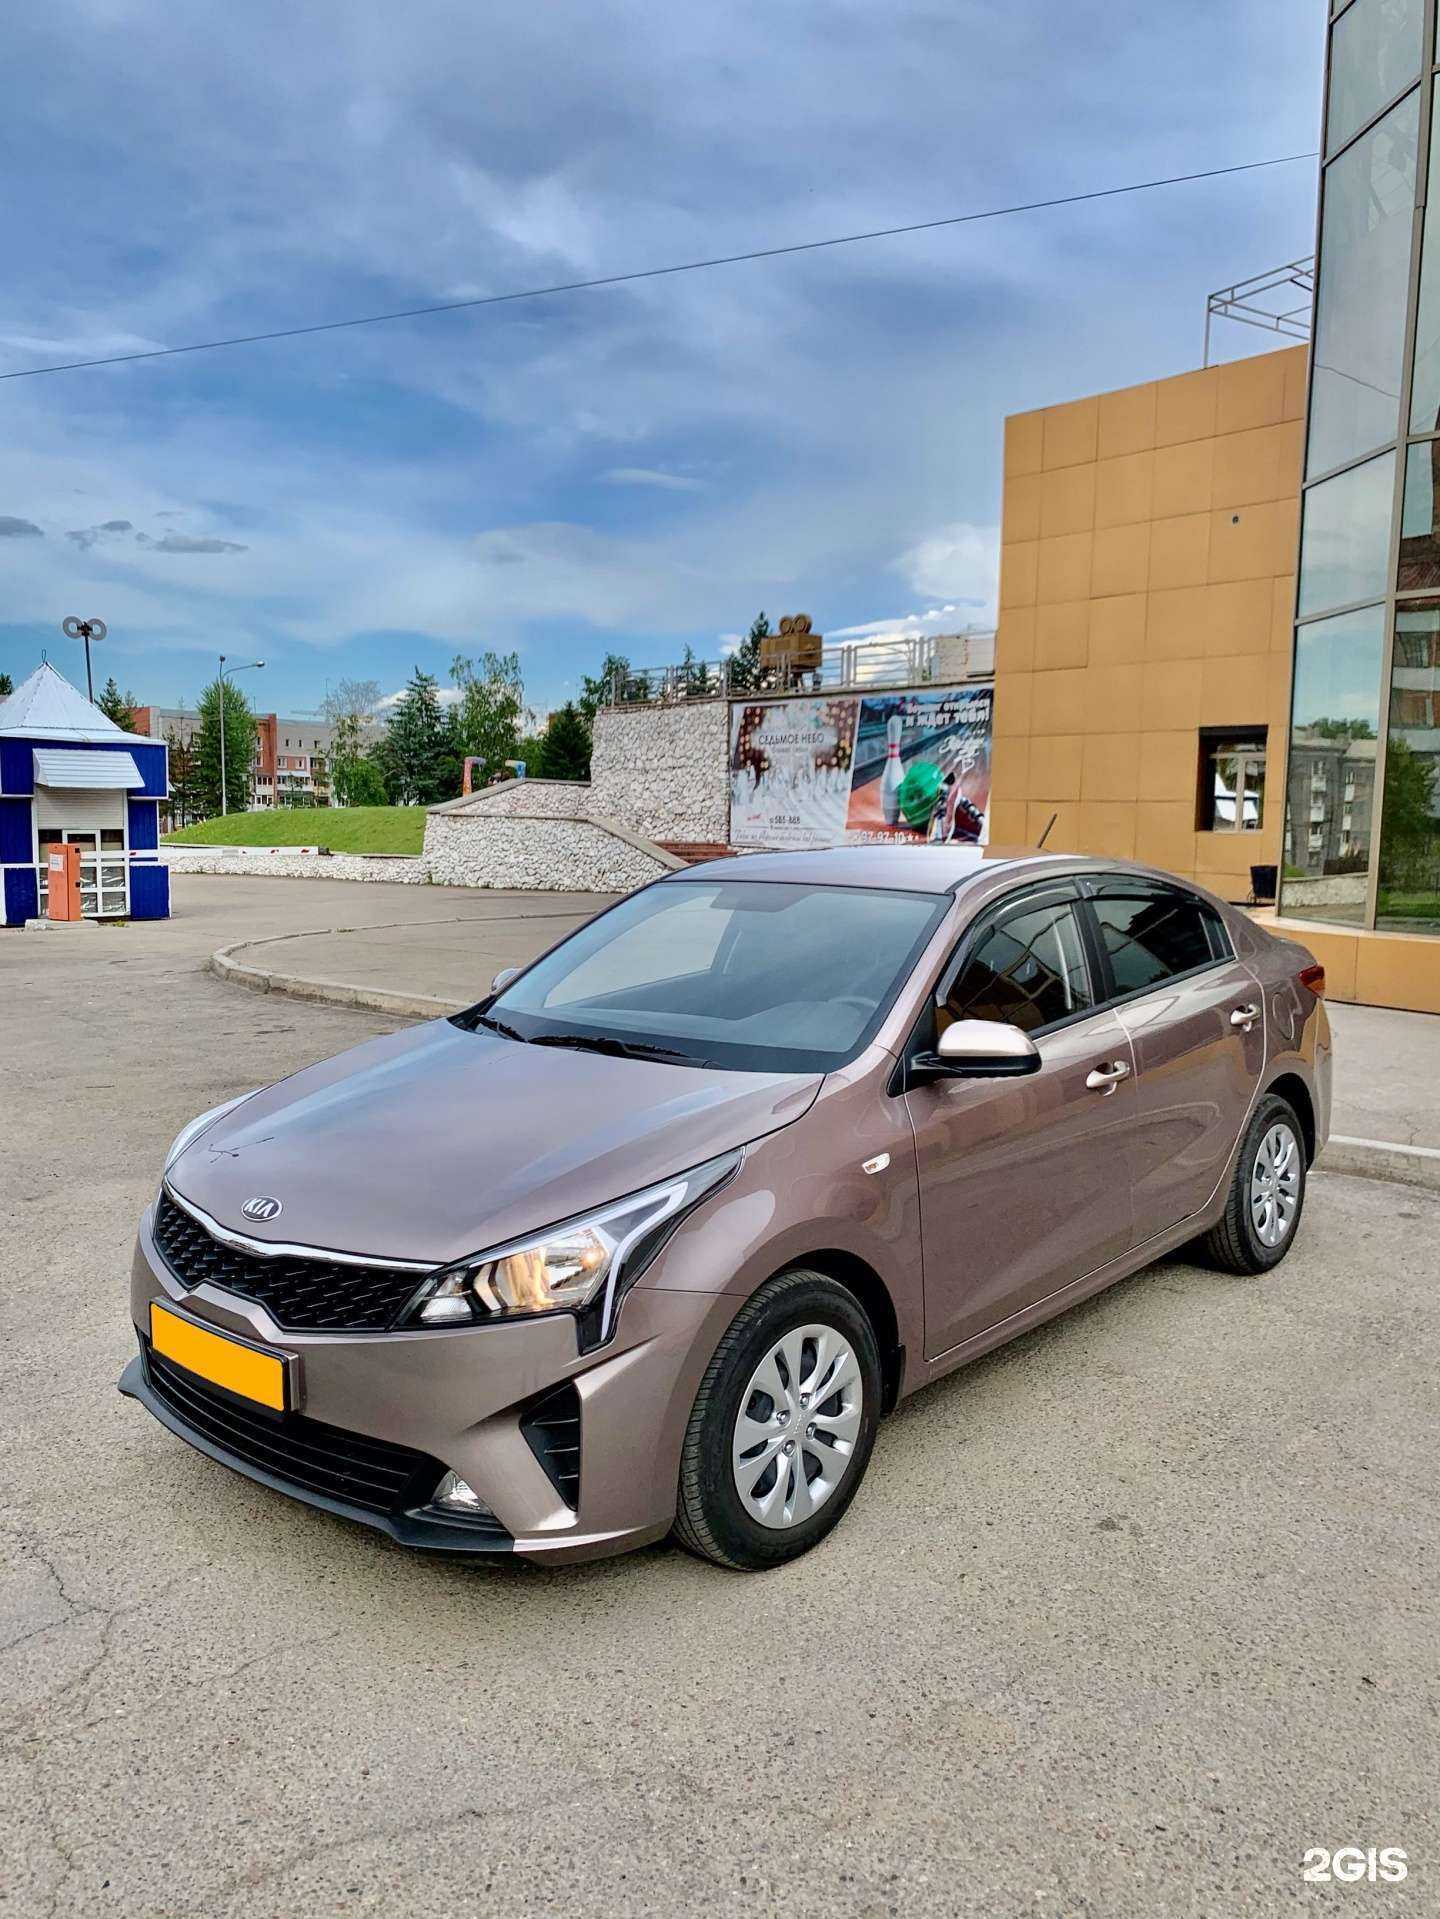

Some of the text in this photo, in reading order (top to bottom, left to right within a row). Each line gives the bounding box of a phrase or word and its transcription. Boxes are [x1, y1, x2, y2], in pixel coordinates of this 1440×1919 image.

[758, 731, 825, 746] СЕДЬМОЕ НЕБО
[243, 1198, 275, 1218] KIA
